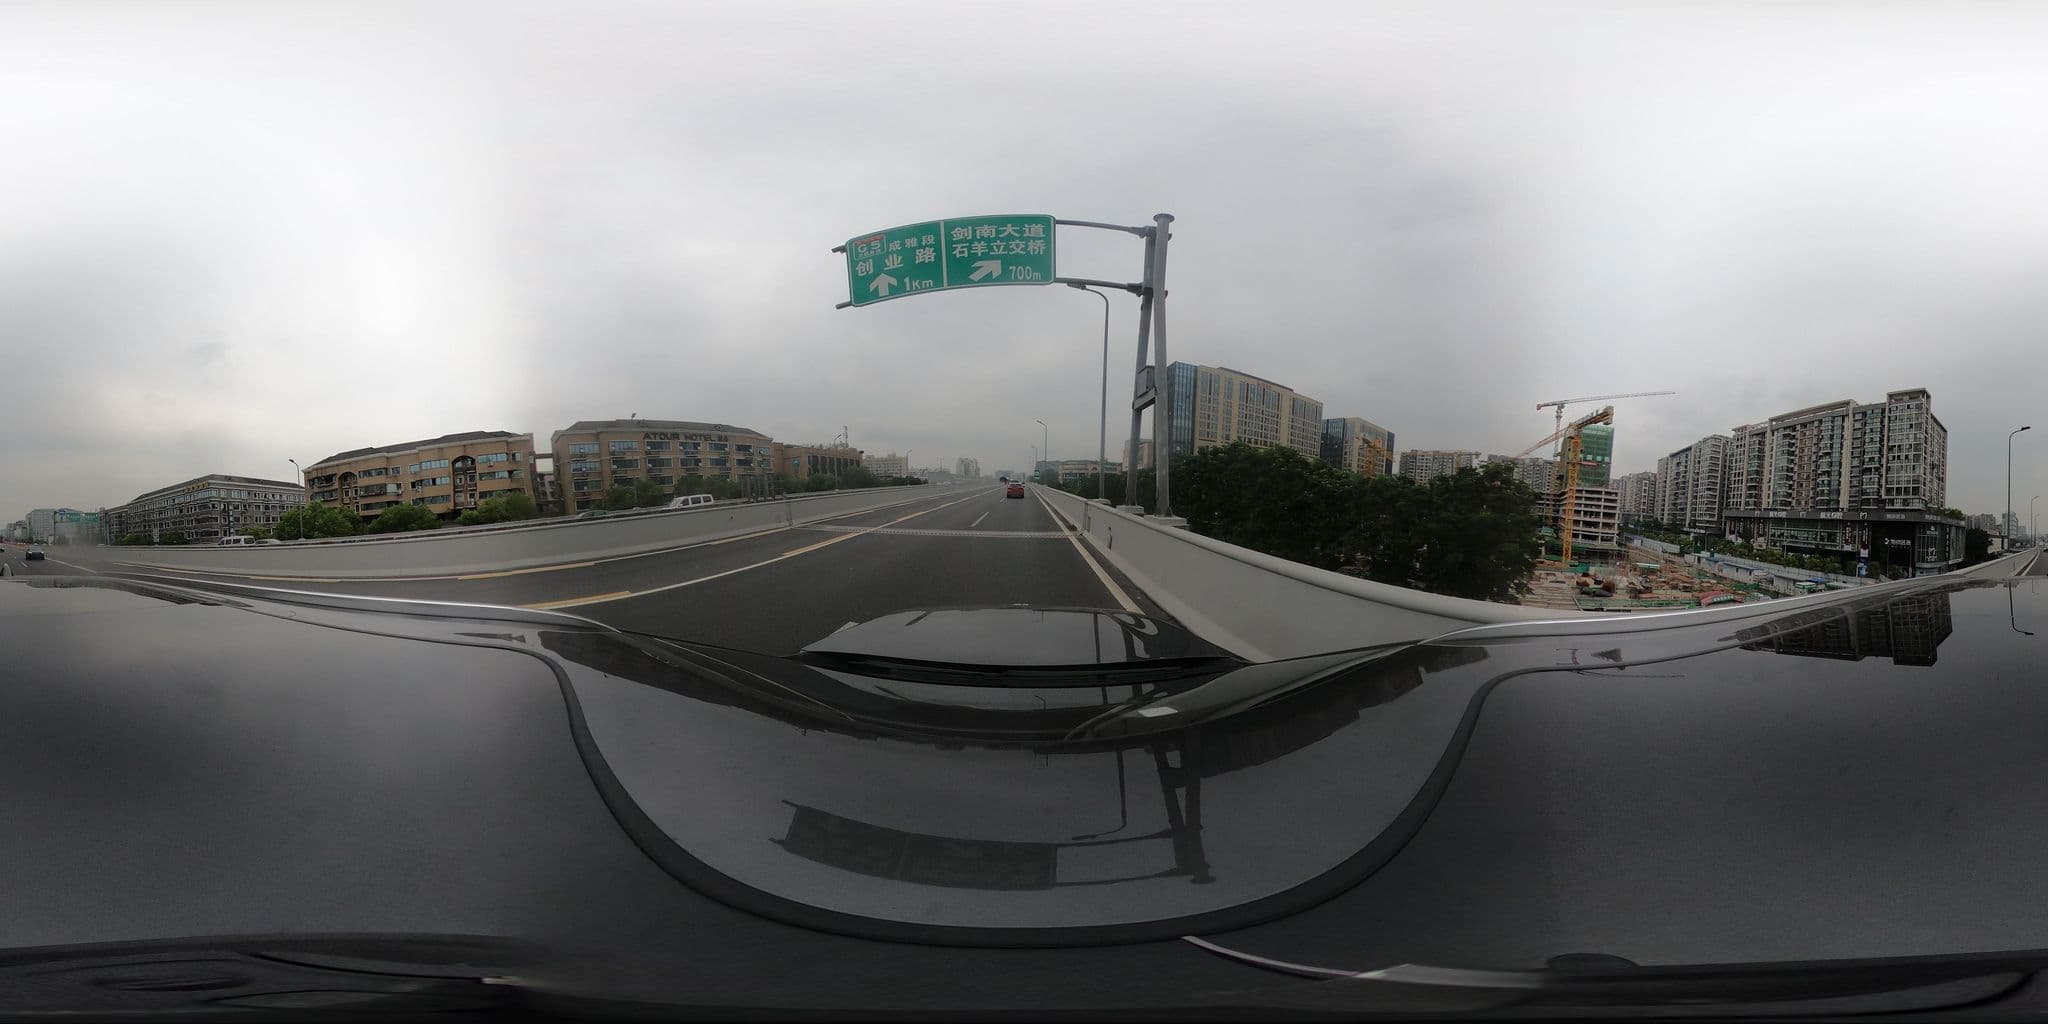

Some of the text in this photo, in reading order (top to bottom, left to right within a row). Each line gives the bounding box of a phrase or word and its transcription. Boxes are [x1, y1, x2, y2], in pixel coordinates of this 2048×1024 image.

[950, 223, 1046, 240] 剑南大道
[888, 235, 936, 252] 成雅段
[952, 240, 1047, 258] 石羊立交桥
[856, 248, 936, 276] 创业路
[1009, 266, 1041, 281] 700m
[643, 432, 680, 441] ATOUR
[684, 433, 716, 442] HOTEL
